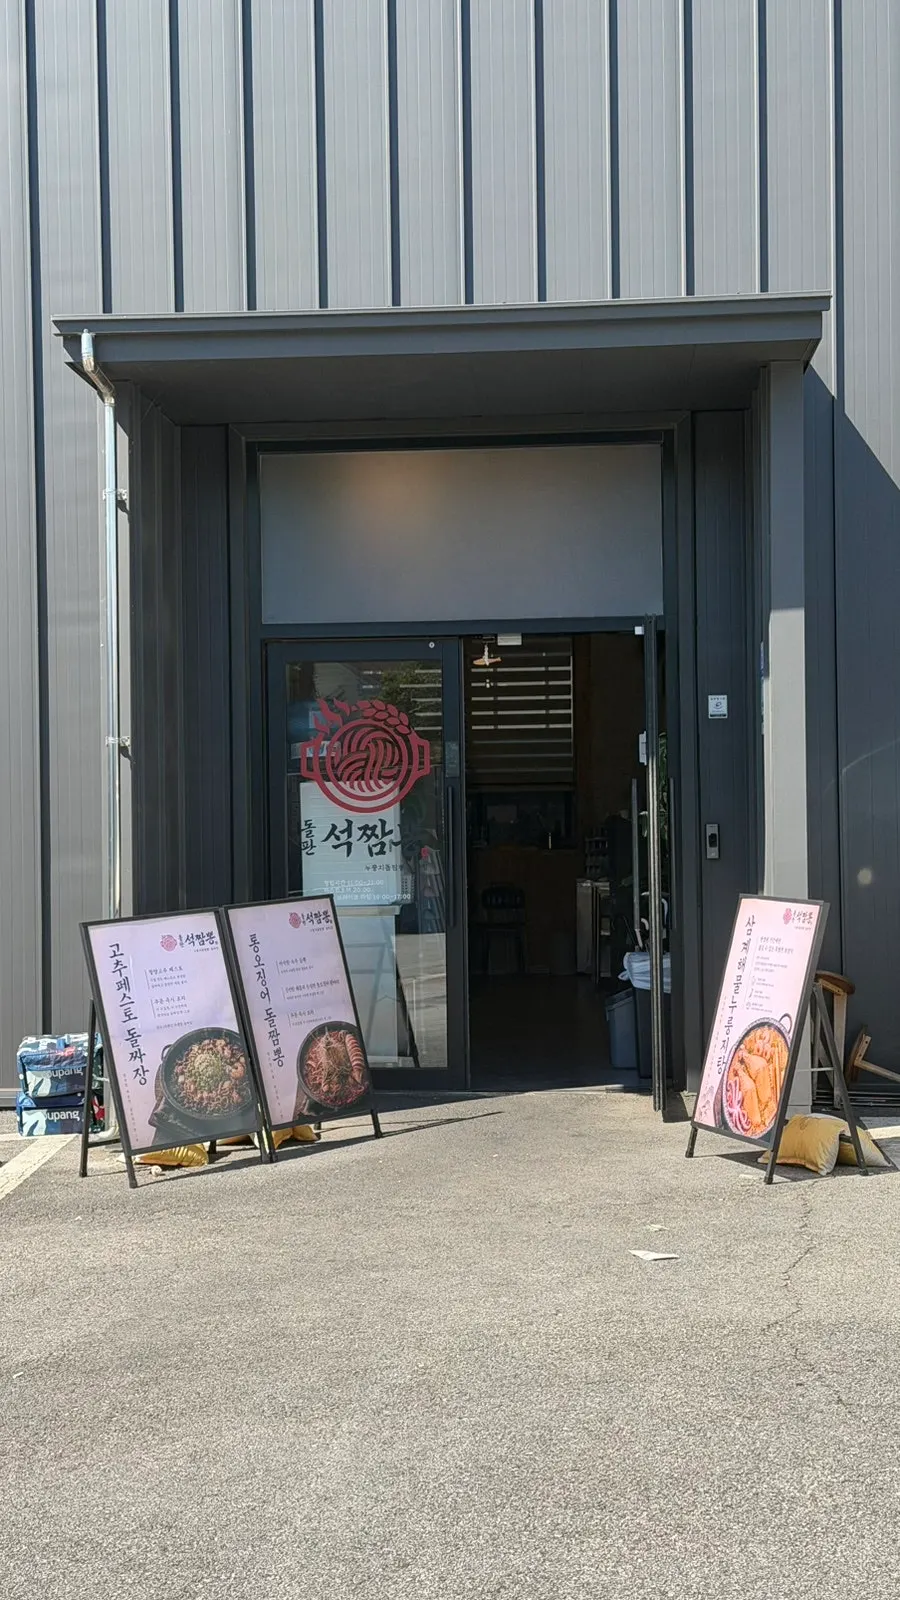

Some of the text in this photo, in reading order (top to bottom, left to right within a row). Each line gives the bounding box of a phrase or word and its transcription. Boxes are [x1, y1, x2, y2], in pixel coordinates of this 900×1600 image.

[300, 818, 405, 858] 돌판 석짬
[184, 930, 217, 947] 석짬뽕
[109, 943, 138, 1023] 고추페스토
[124, 1027, 150, 1086] 돌짜장
[248, 933, 271, 1004] 통오징어
[264, 1007, 285, 1067] 돌짬뽕
